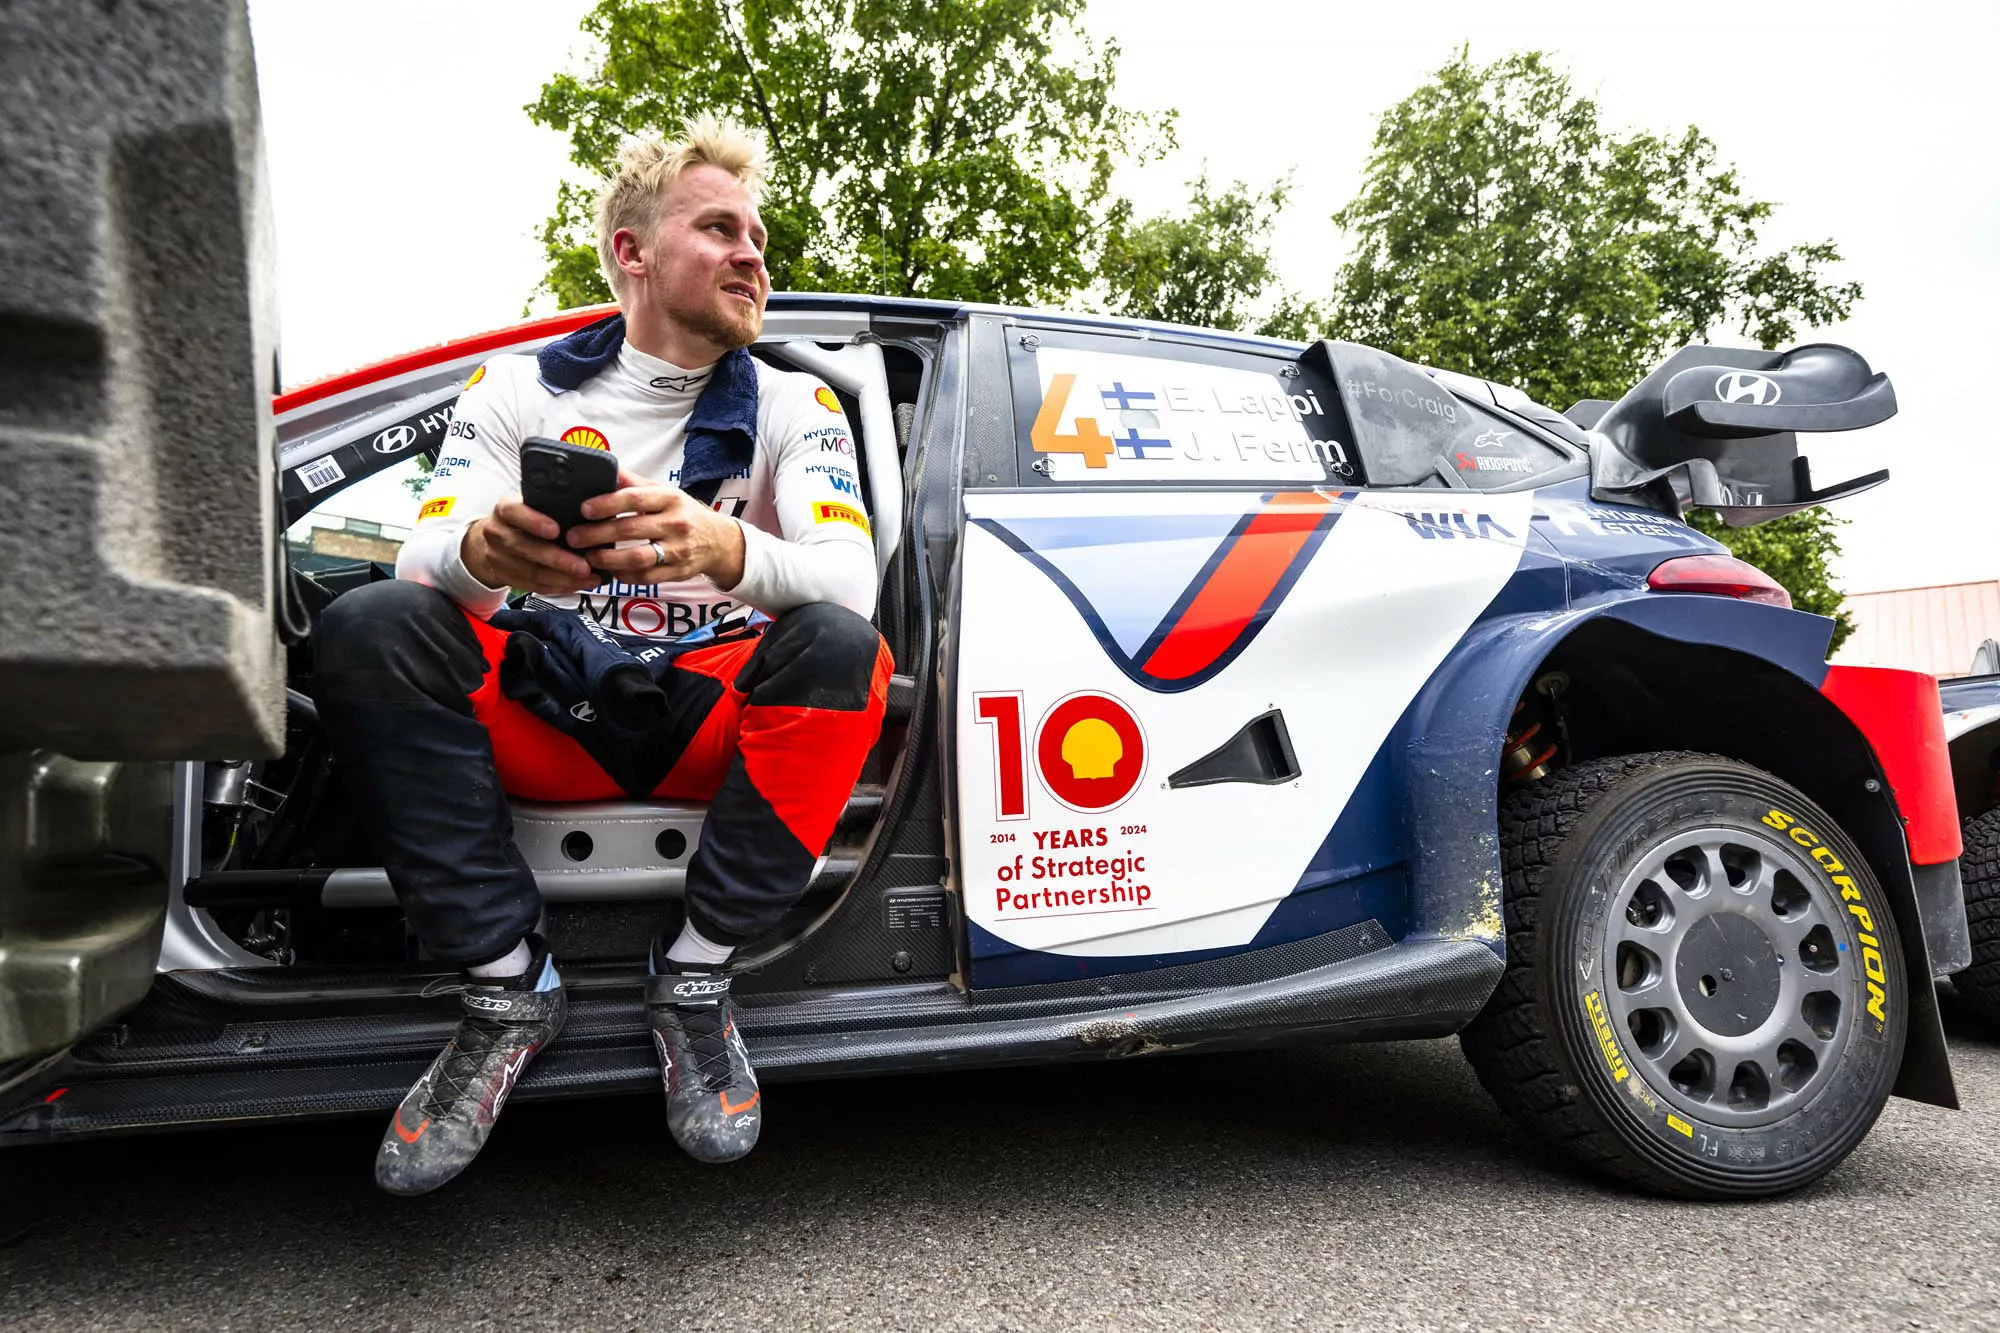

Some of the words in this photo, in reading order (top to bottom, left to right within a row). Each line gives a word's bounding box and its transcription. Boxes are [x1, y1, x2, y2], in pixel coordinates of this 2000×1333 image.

[1162, 384, 1205, 413] E.
[1211, 387, 1325, 423] Lappi
[1344, 379, 1456, 423] #ForCraig
[1031, 373, 1115, 469] 4
[1183, 431, 1221, 461] J.
[1231, 431, 1348, 464] Ferm
[1404, 509, 1516, 539] WIA
[1602, 523, 1683, 538] STEEL
[973, 690, 1149, 821] 10
[990, 833, 1016, 844] 2014
[1033, 827, 1108, 850] YEARS
[1120, 825, 1147, 835] 2024
[997, 855, 1023, 882] of
[1032, 849, 1146, 880] Strategic
[996, 878, 1152, 911] Partnership
[1762, 808, 1886, 1023] SCORPION
[1584, 991, 1629, 1083] PIRELLI
[1639, 1089, 1656, 1112] WRC
